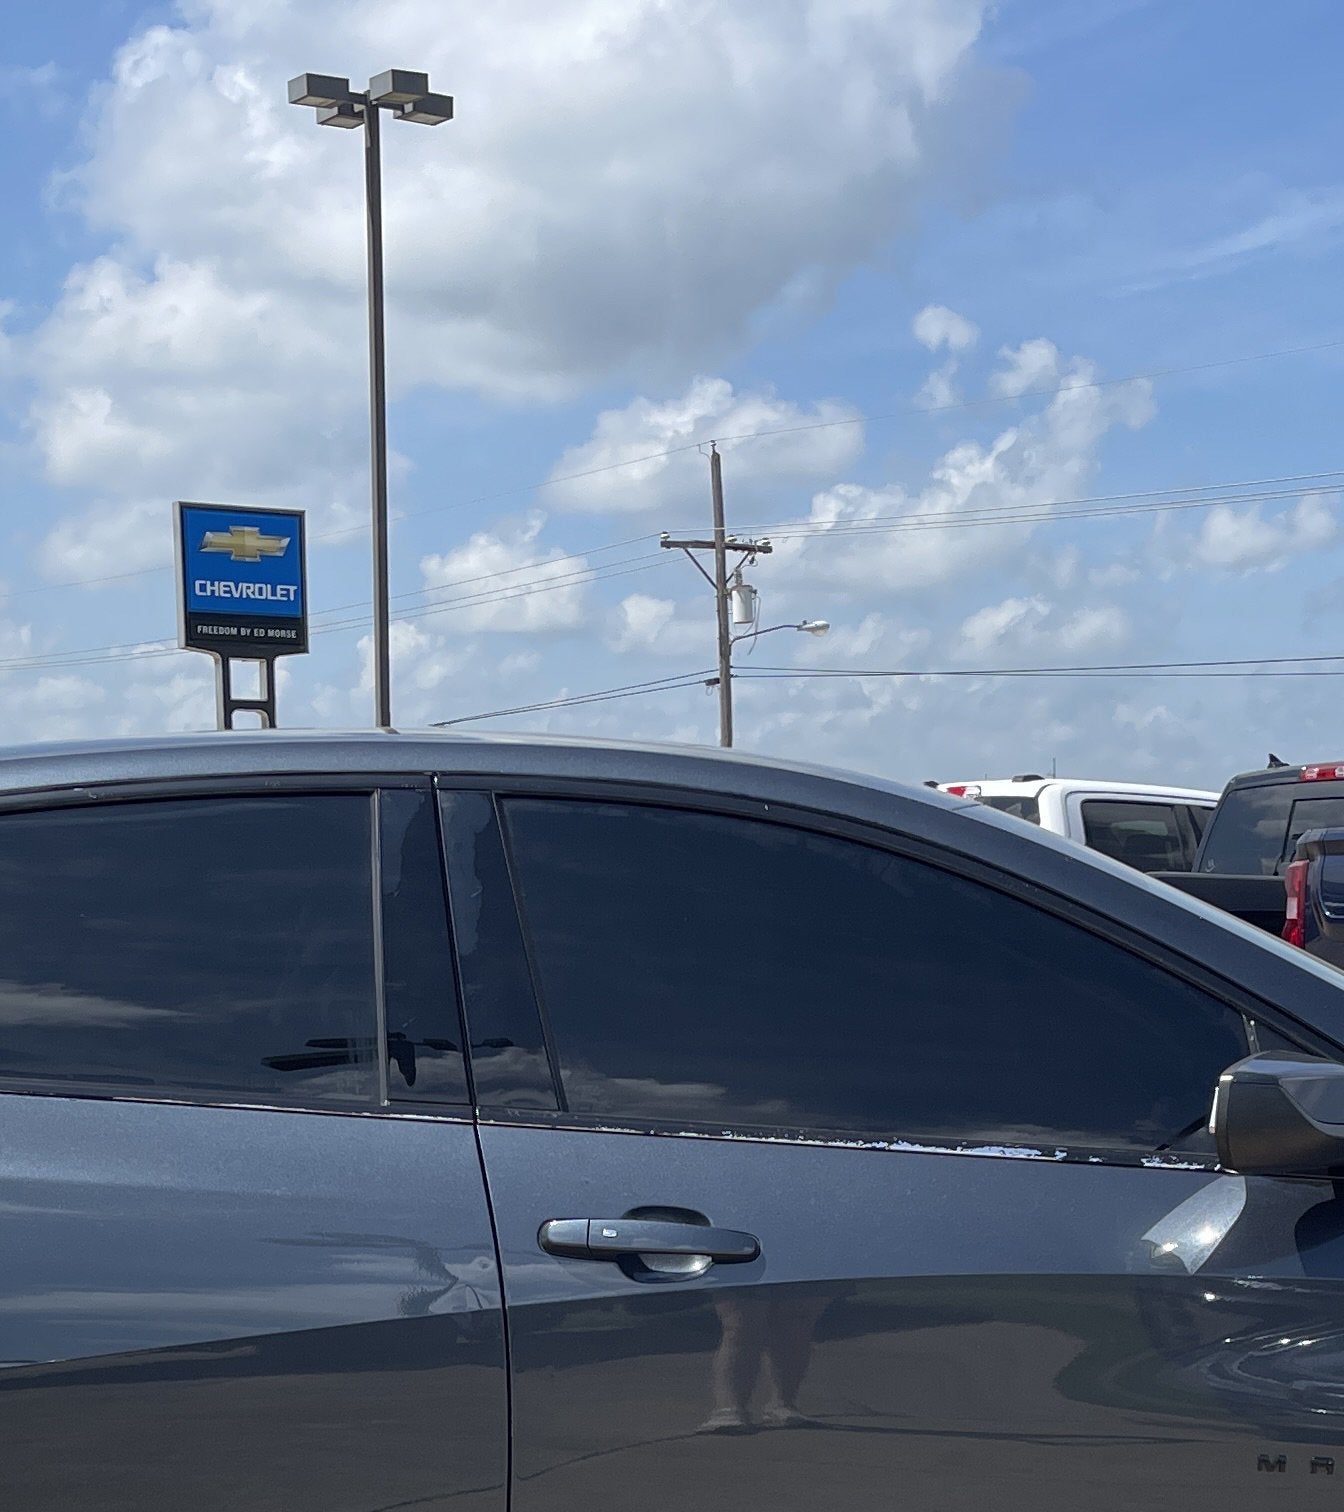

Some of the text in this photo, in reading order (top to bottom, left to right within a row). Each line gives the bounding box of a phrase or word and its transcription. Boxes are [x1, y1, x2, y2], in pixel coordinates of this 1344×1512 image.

[195, 580, 298, 601] CHEVROLET
[197, 625, 297, 639] FREEDOM BY ED MORSE
